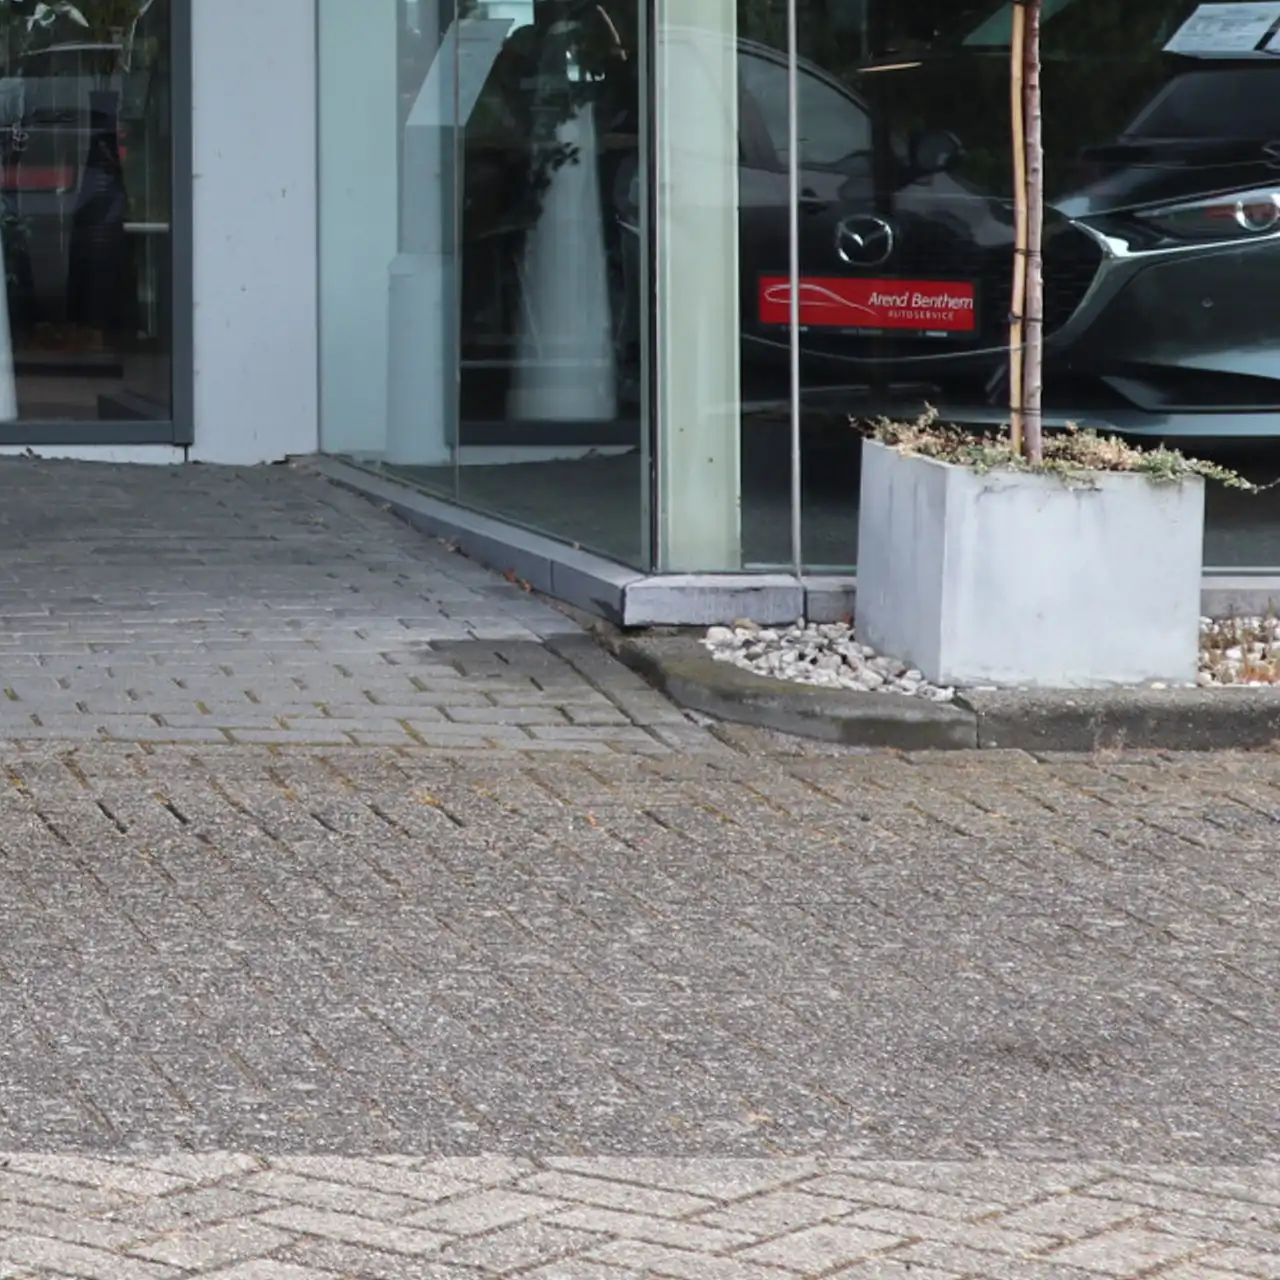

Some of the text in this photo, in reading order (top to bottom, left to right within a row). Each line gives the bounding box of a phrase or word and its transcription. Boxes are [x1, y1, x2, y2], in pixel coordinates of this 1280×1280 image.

[868, 292, 973, 309] Arend Benthem
[888, 310, 954, 321] AUTOSERVICE
